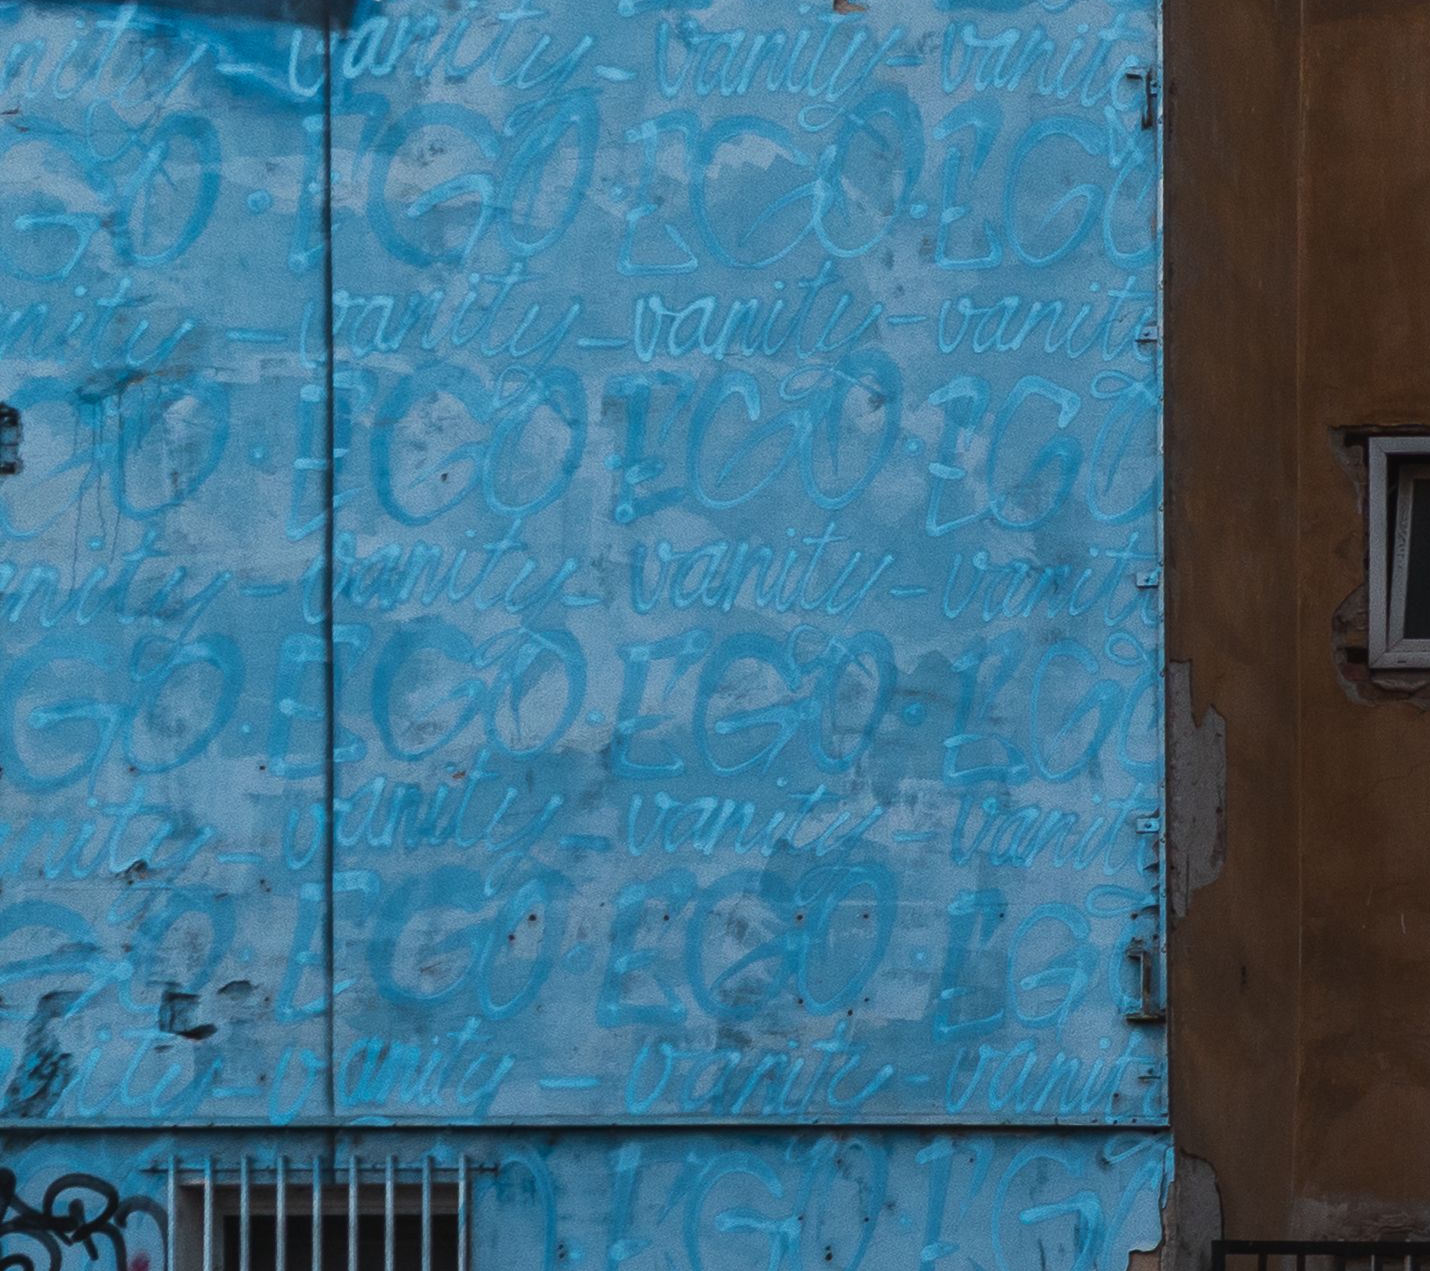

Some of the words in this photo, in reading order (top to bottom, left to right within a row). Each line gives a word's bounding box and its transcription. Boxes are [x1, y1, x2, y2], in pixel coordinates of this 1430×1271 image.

[653, 8, 904, 102] vanity
[616, 93, 920, 276] EGO
[298, 260, 582, 368] vanity
[630, 258, 886, 362] vanity
[302, 520, 582, 628] vanity
[630, 521, 894, 618] vanity
[611, 623, 901, 782] EGO
[282, 748, 562, 873] vanity
[625, 771, 887, 860] vanity
[264, 1016, 517, 1120] vanity
[623, 1020, 897, 1120] vanity
